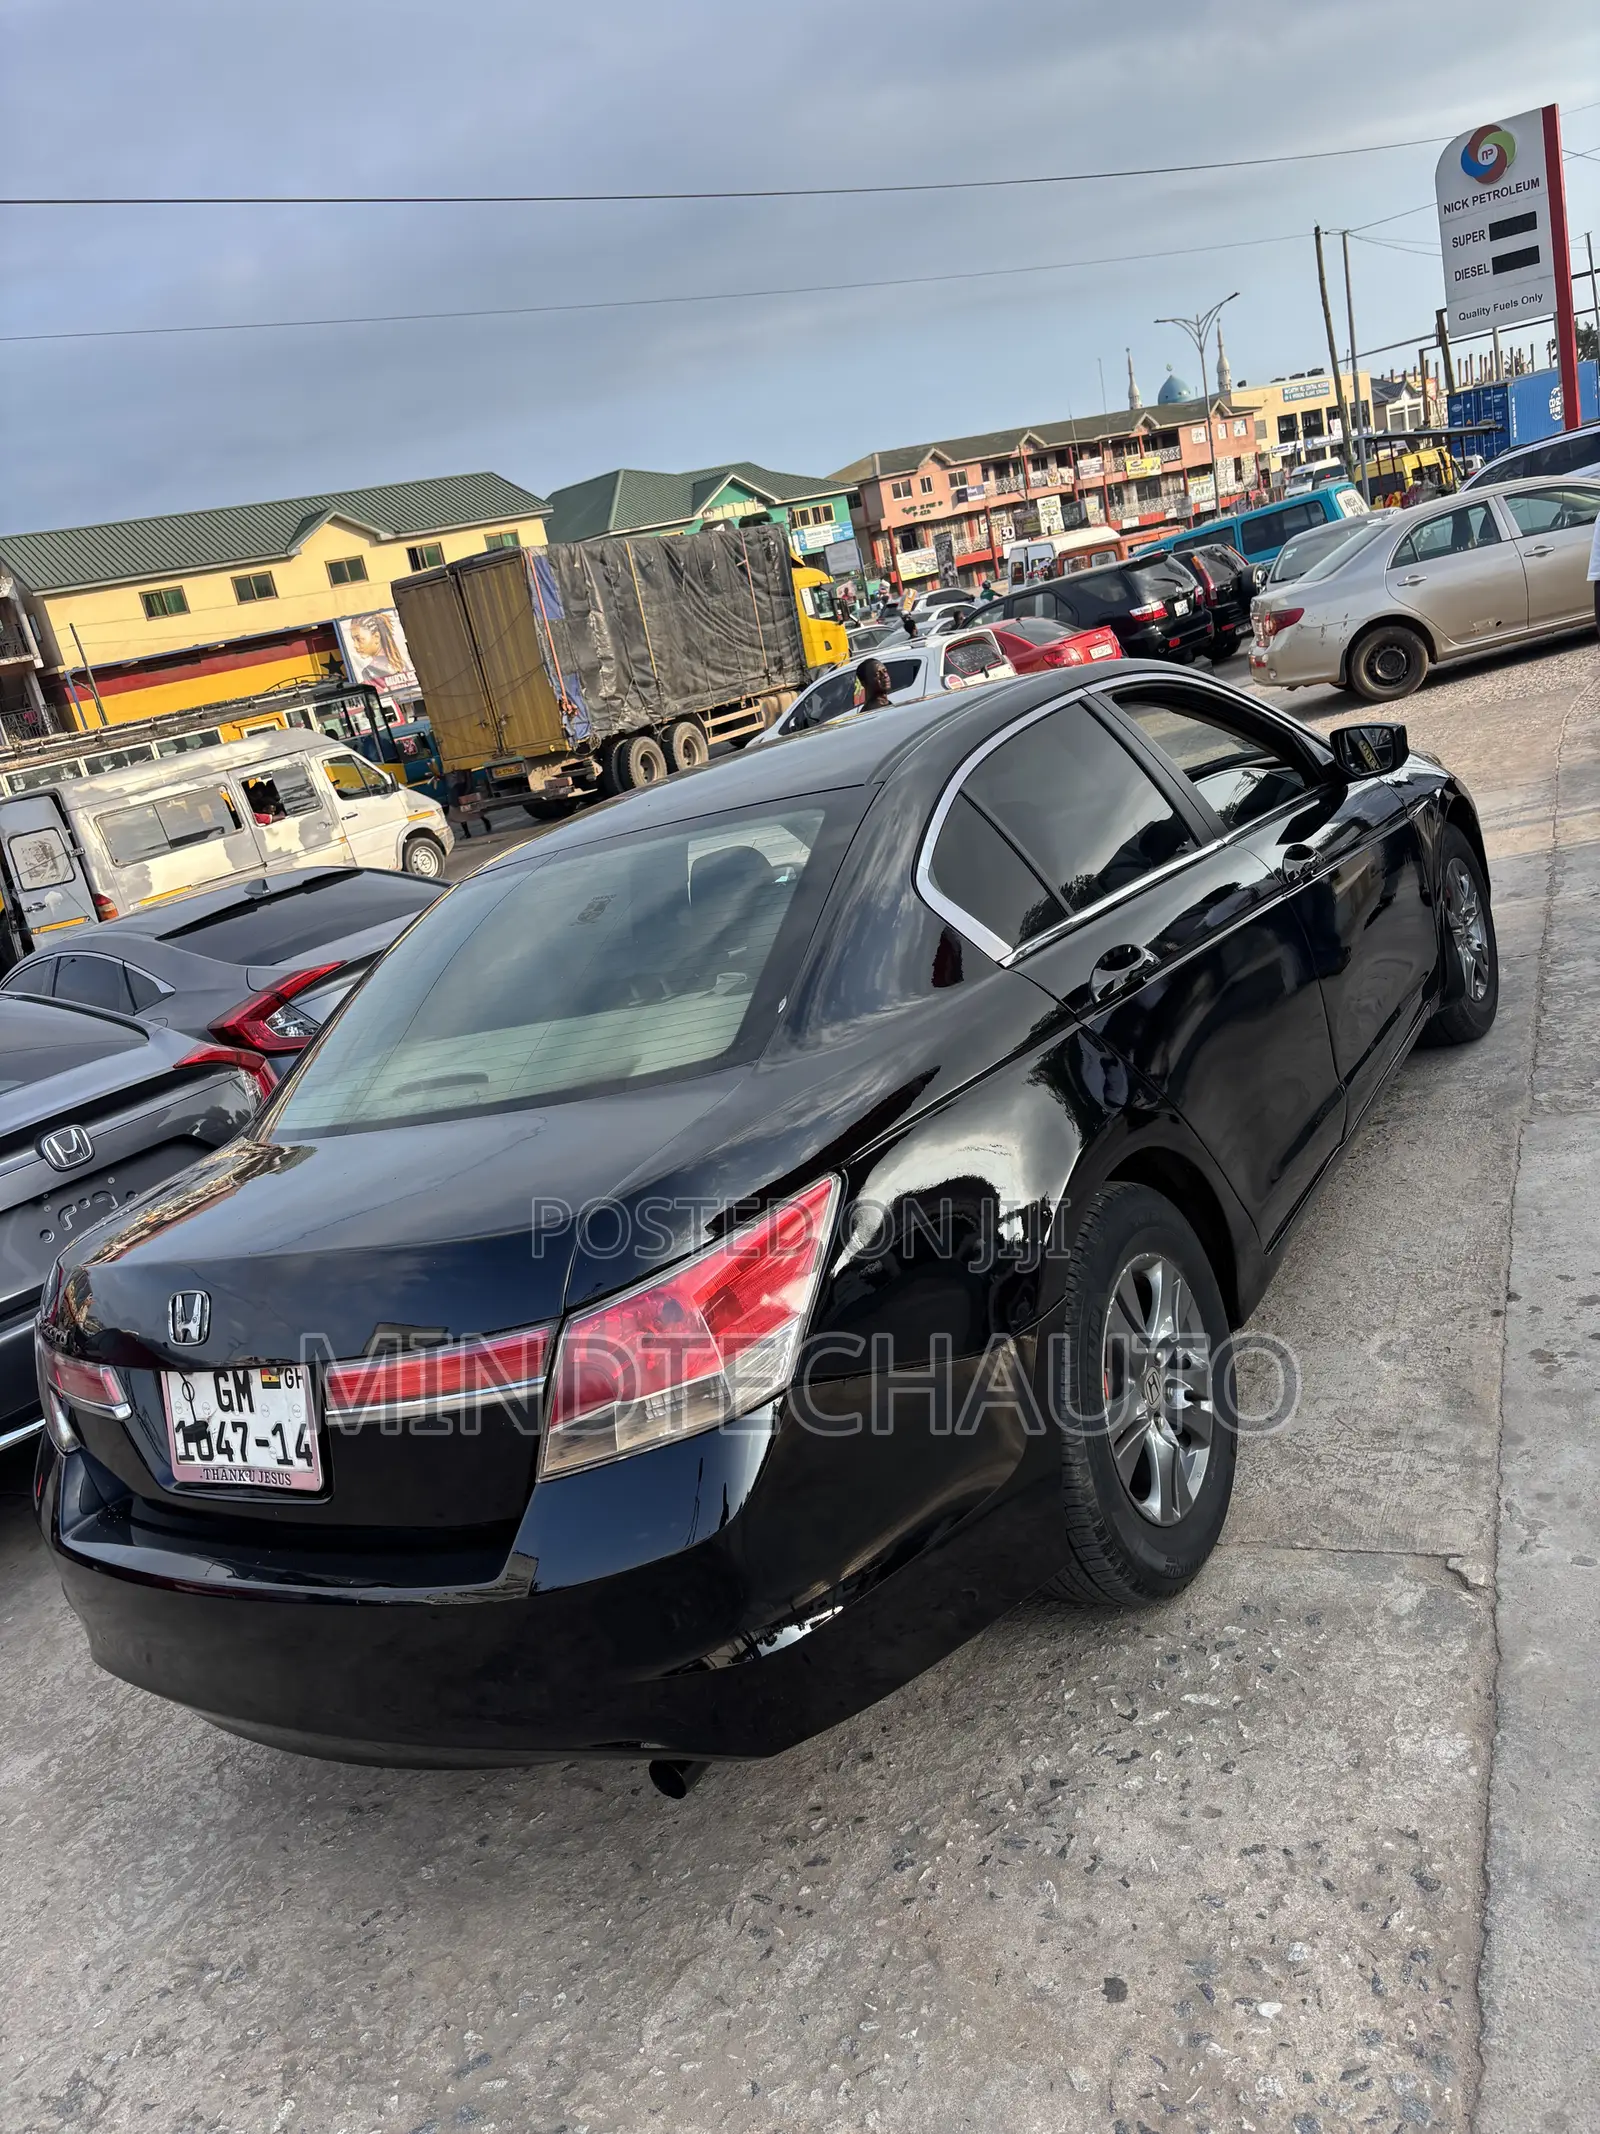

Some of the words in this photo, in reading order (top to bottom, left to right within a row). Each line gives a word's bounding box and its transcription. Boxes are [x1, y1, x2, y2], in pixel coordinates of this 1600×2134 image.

[1443, 198, 1470, 215] NICK
[1472, 177, 1541, 207] PETROLEUM
[1452, 229, 1486, 249] SUPER
[1454, 263, 1490, 282] DIESEL
[1458, 306, 1491, 322] Quality
[1493, 298, 1519, 313] Fuels
[1521, 293, 1544, 306] Only
[1001, 526, 1015, 540] 3D
[213, 1370, 255, 1413] GM
[203, 1468, 246, 1482] THANK
[258, 1469, 292, 1487] JESUS
